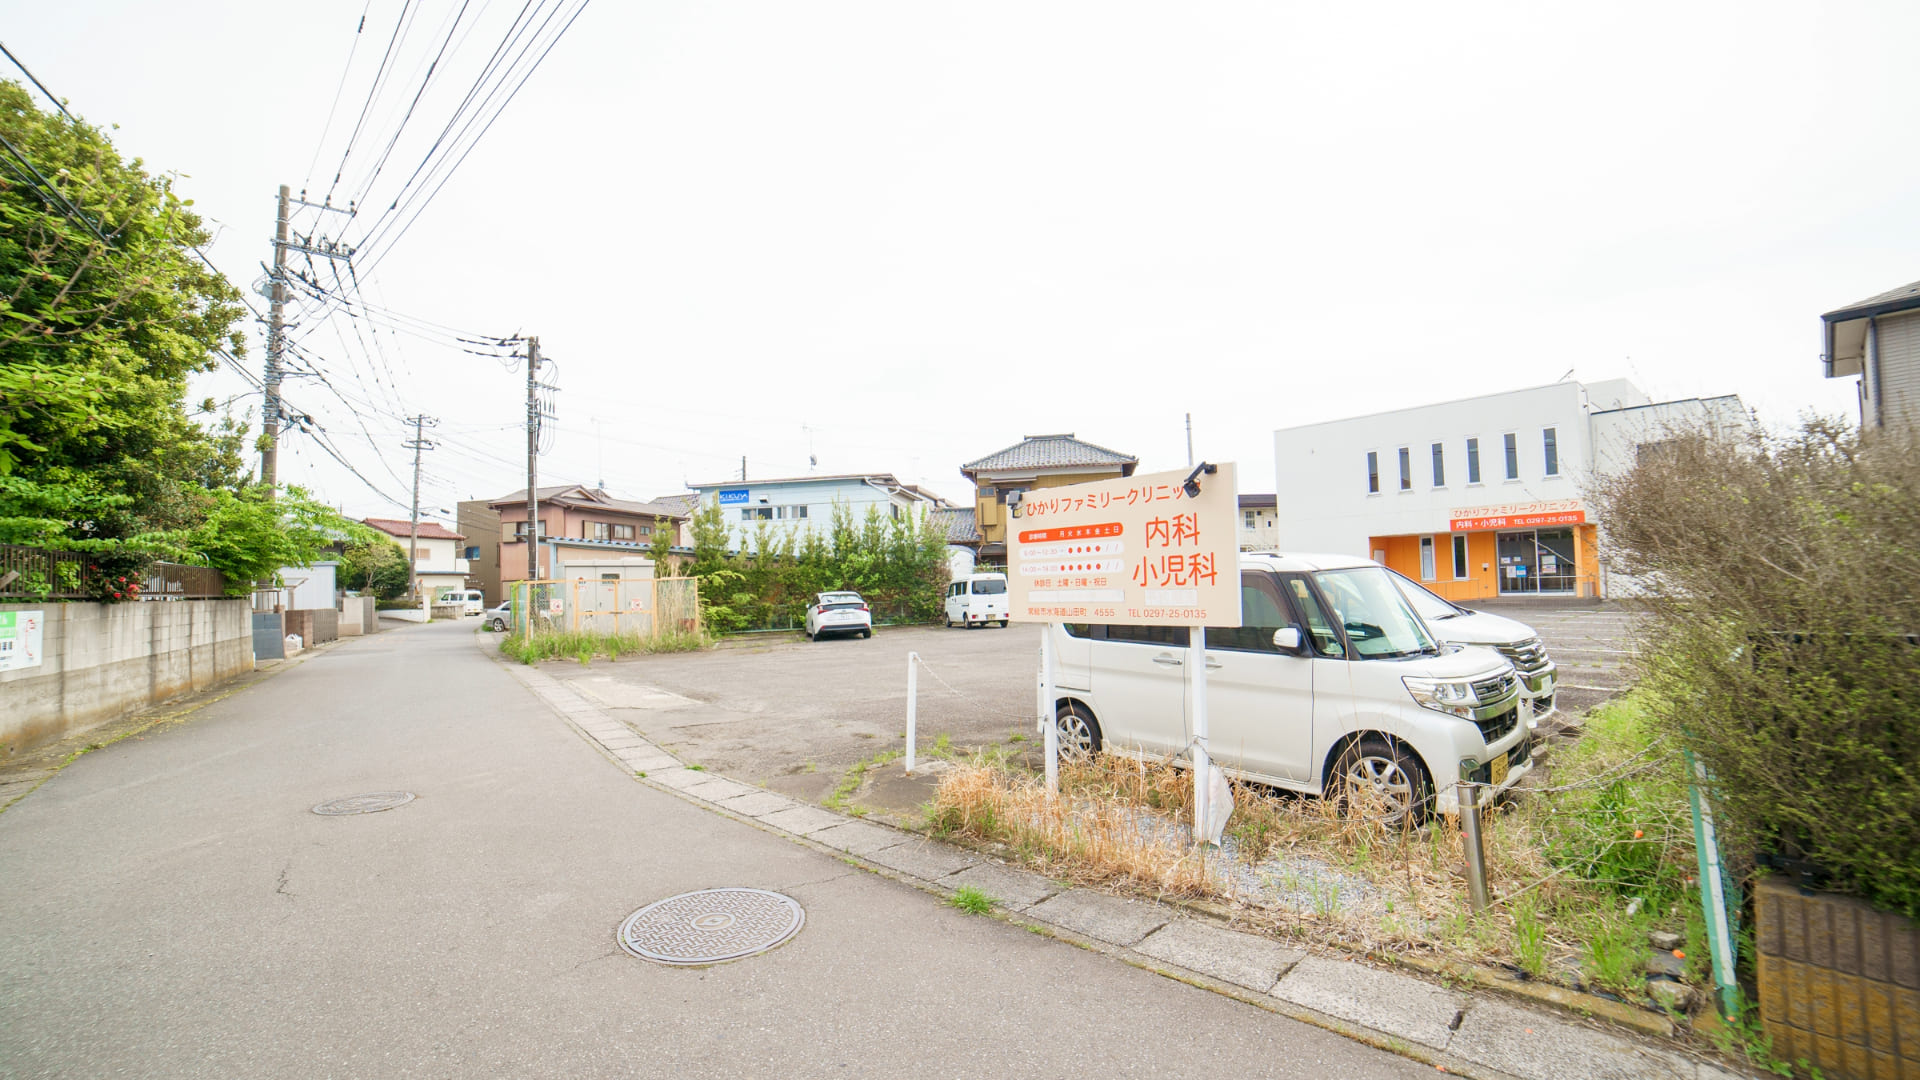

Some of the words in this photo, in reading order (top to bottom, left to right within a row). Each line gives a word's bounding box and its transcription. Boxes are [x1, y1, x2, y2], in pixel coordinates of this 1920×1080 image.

[1026, 484, 1200, 517] ひかりファミリークリニッ
[1454, 501, 1579, 518] ひかりファミリークリニック
[1145, 512, 1201, 549] 内科
[1132, 552, 1218, 588] 小児科
[1094, 608, 1115, 617] 4555
[1128, 608, 1141, 618] TEL
[1143, 609, 1207, 619] 0297-25-0135
